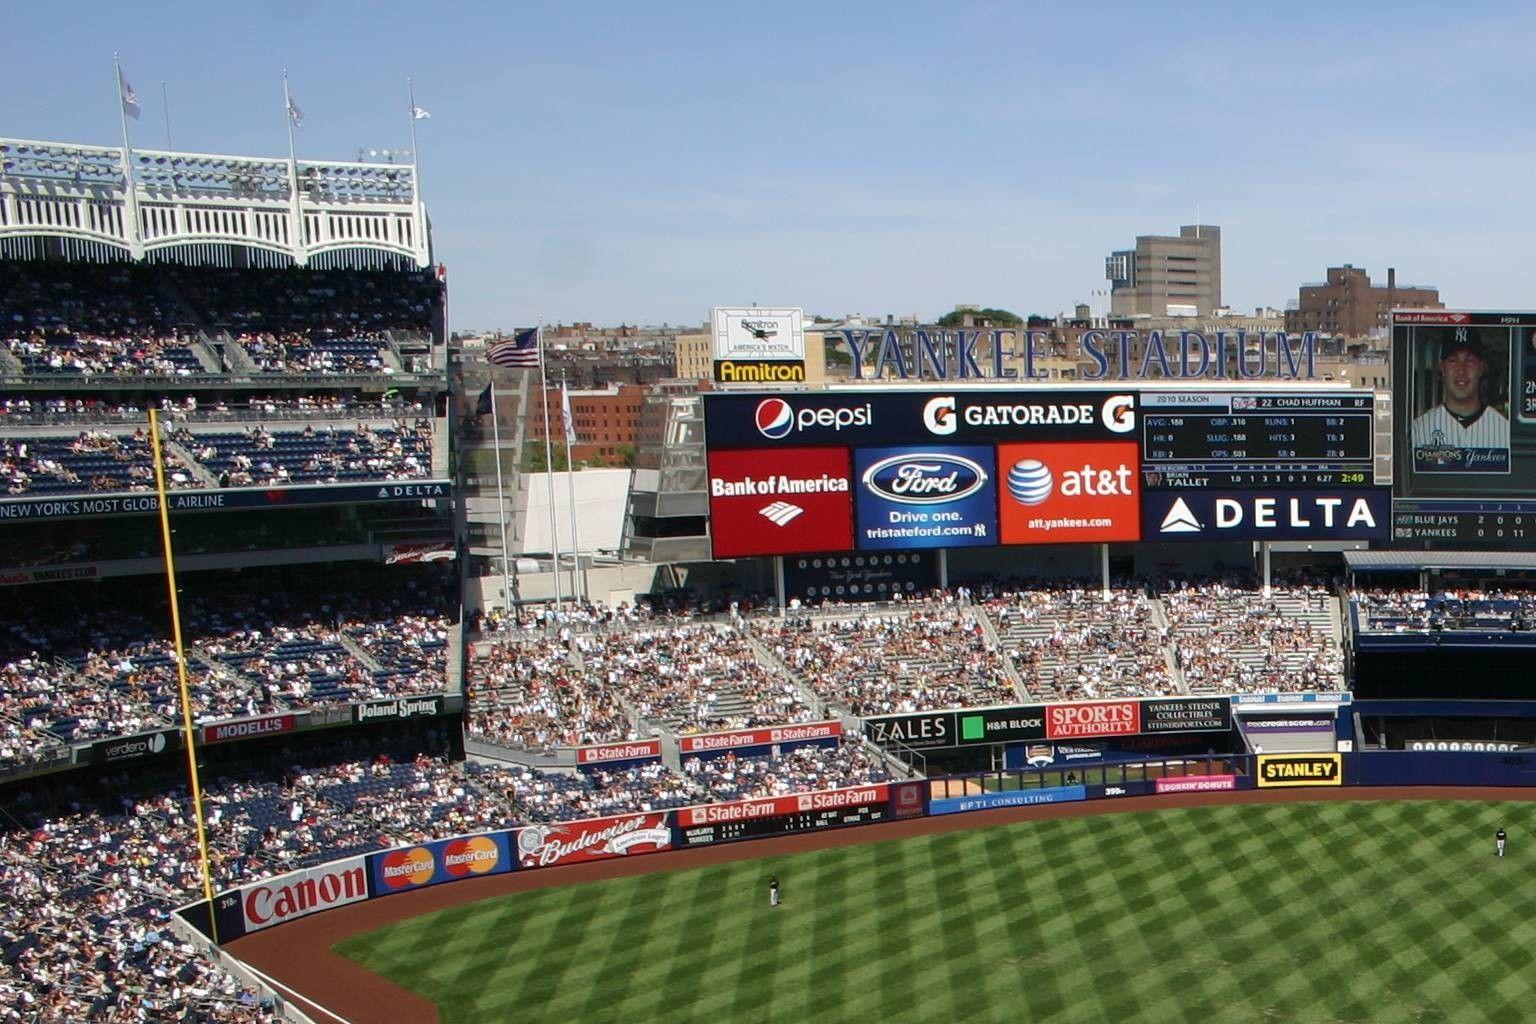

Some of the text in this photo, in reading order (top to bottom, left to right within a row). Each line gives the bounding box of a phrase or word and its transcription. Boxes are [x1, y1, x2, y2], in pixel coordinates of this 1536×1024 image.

[1420, 314, 1448, 322] America
[842, 328, 1320, 381] YANKEE STADIUM
[720, 361, 804, 381] Armitron
[1177, 395, 1210, 403] SEASON
[1262, 399, 1342, 407] 22 CHAD HUFFMAN
[798, 404, 873, 431] pepsi
[963, 404, 1094, 426] GATORADE
[1464, 449, 1507, 468] Yankees
[711, 474, 849, 497] Bank of America
[892, 463, 957, 494] Ford
[1060, 463, 1133, 496] at&t
[1166, 473, 1365, 487] TALLET 2:49
[393, 485, 443, 496] DELTA
[1, 505, 32, 518] NEW
[34, 501, 81, 516] YORK'S
[83, 500, 120, 513] MOST
[177, 495, 225, 508] AIRLINE
[1215, 497, 1377, 529] DELTA
[889, 511, 963, 523] Drive one.
[1027, 515, 1112, 530] att.yankees.com
[1414, 515, 1459, 525] BLUE JAYS
[867, 525, 972, 538] tristateford.com
[1414, 528, 1457, 538] YANKEES
[1513, 529, 1525, 538] 11
[358, 700, 437, 722] Poland Spring
[1052, 702, 1134, 725] SPORTS
[1156, 709, 1213, 720] COLLECTIBLES
[216, 719, 283, 739] MODELL'S
[782, 725, 830, 741] State Farm
[875, 717, 946, 743] ZALES
[986, 718, 1042, 732] H&R BLOCK
[1052, 720, 1134, 736] AUTHORITY
[703, 733, 754, 750] State Farm
[599, 745, 651, 761] State Farm
[1266, 762, 1333, 777] STANLEY
[813, 789, 877, 809] State Farm
[992, 793, 1053, 808] CONSULTING
[707, 802, 775, 822] State Farm
[539, 814, 646, 867] Budweiser
[445, 848, 499, 867] MasterCard
[384, 859, 435, 879] MasterCard
[245, 866, 366, 924] Canon
